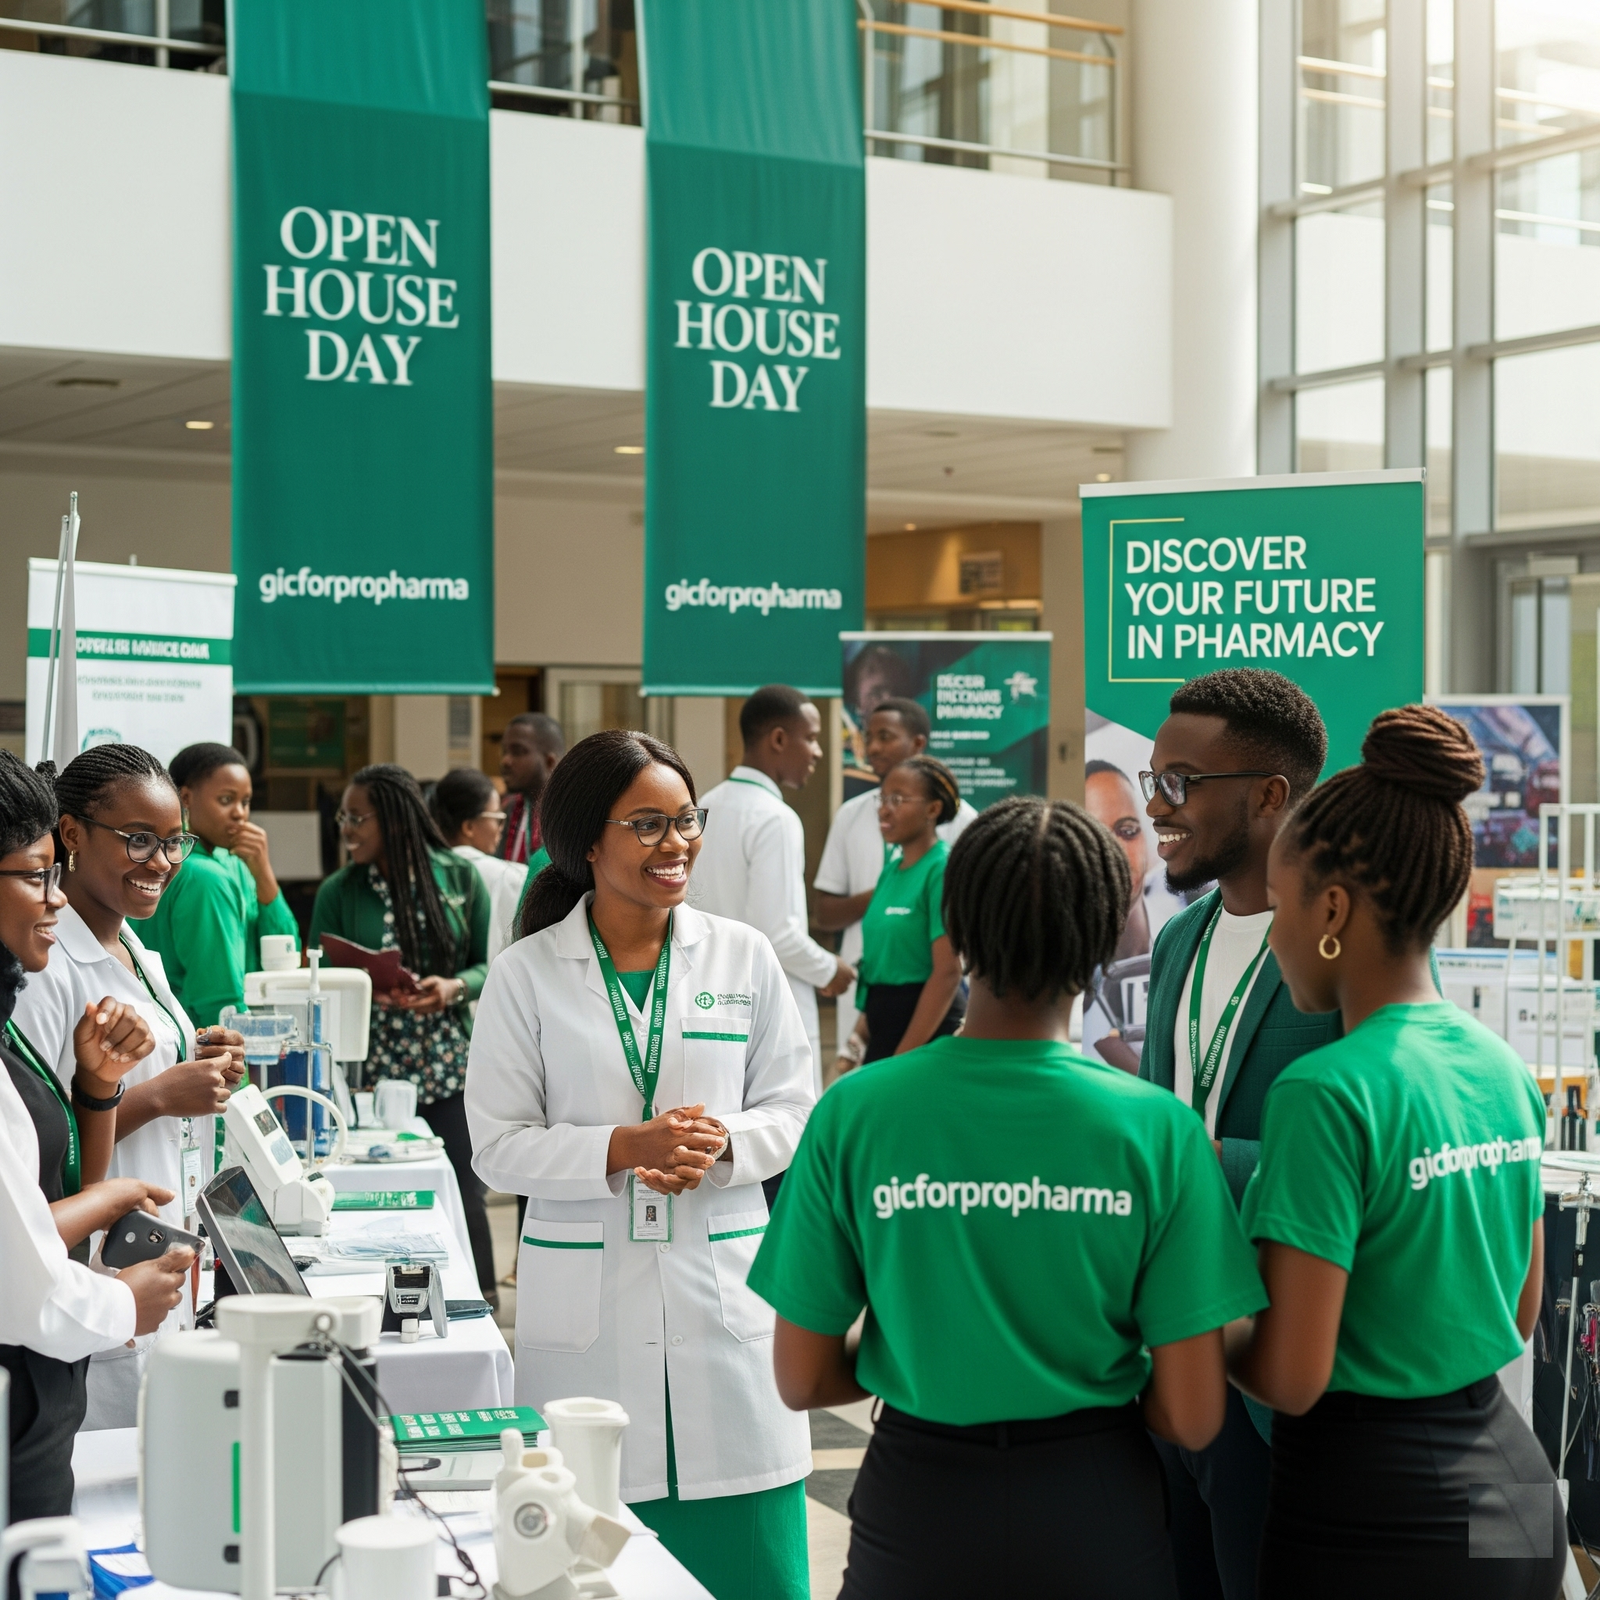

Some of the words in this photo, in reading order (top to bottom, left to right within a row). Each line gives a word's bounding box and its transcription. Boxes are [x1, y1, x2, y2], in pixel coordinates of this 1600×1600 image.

[279, 206, 440, 269] OPEN
[263, 264, 460, 329] HOUSE
[692, 247, 827, 305] OPEN
[674, 300, 842, 360] HOUSE
[305, 329, 421, 386] DAY
[709, 360, 809, 413] DAY
[1125, 535, 1308, 575] DISCOVER
[258, 567, 470, 606] gicforpropharma
[664, 577, 843, 617] gicforpropharma
[1124, 581, 1225, 617] YOUR
[1233, 577, 1377, 615] FUTURE
[1127, 624, 1164, 660] IN
[1173, 621, 1386, 660] PHARMACY
[872, 1172, 1133, 1220] gicforpropharma
